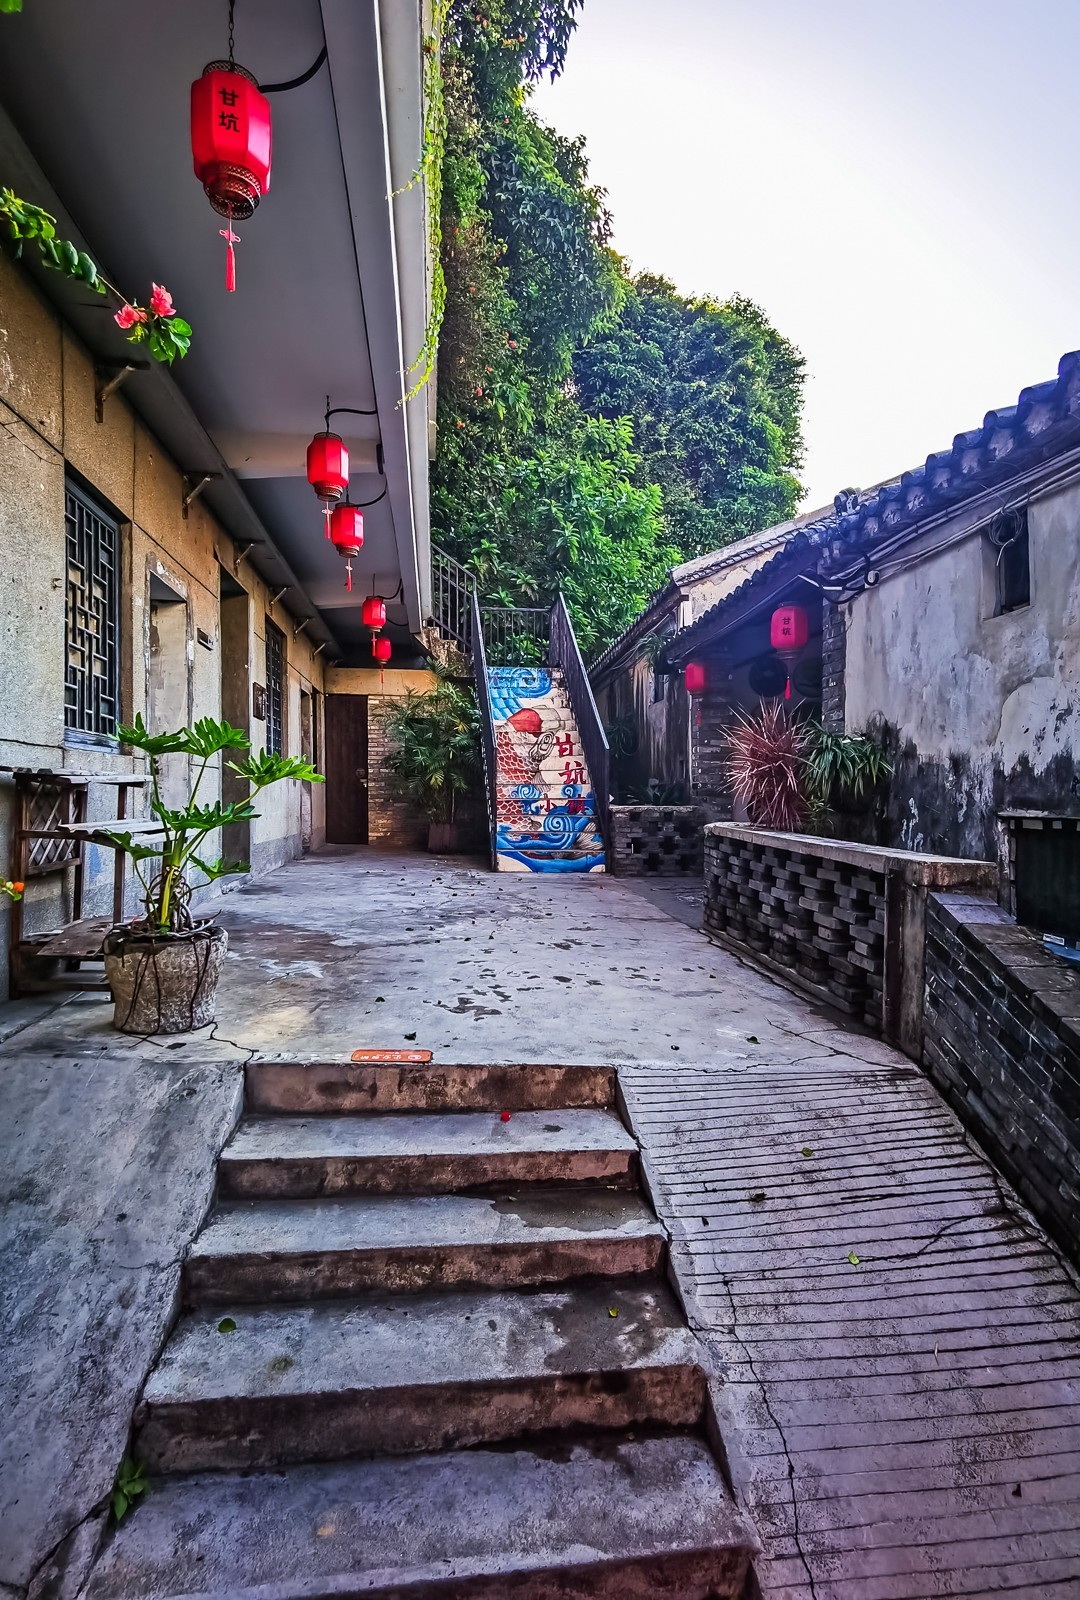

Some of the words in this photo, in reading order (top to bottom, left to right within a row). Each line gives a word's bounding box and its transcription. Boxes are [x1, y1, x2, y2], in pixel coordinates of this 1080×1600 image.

[219, 87, 240, 132] 甘坑
[782, 617, 791, 636] 甘坑
[555, 732, 586, 784] 甘坑
